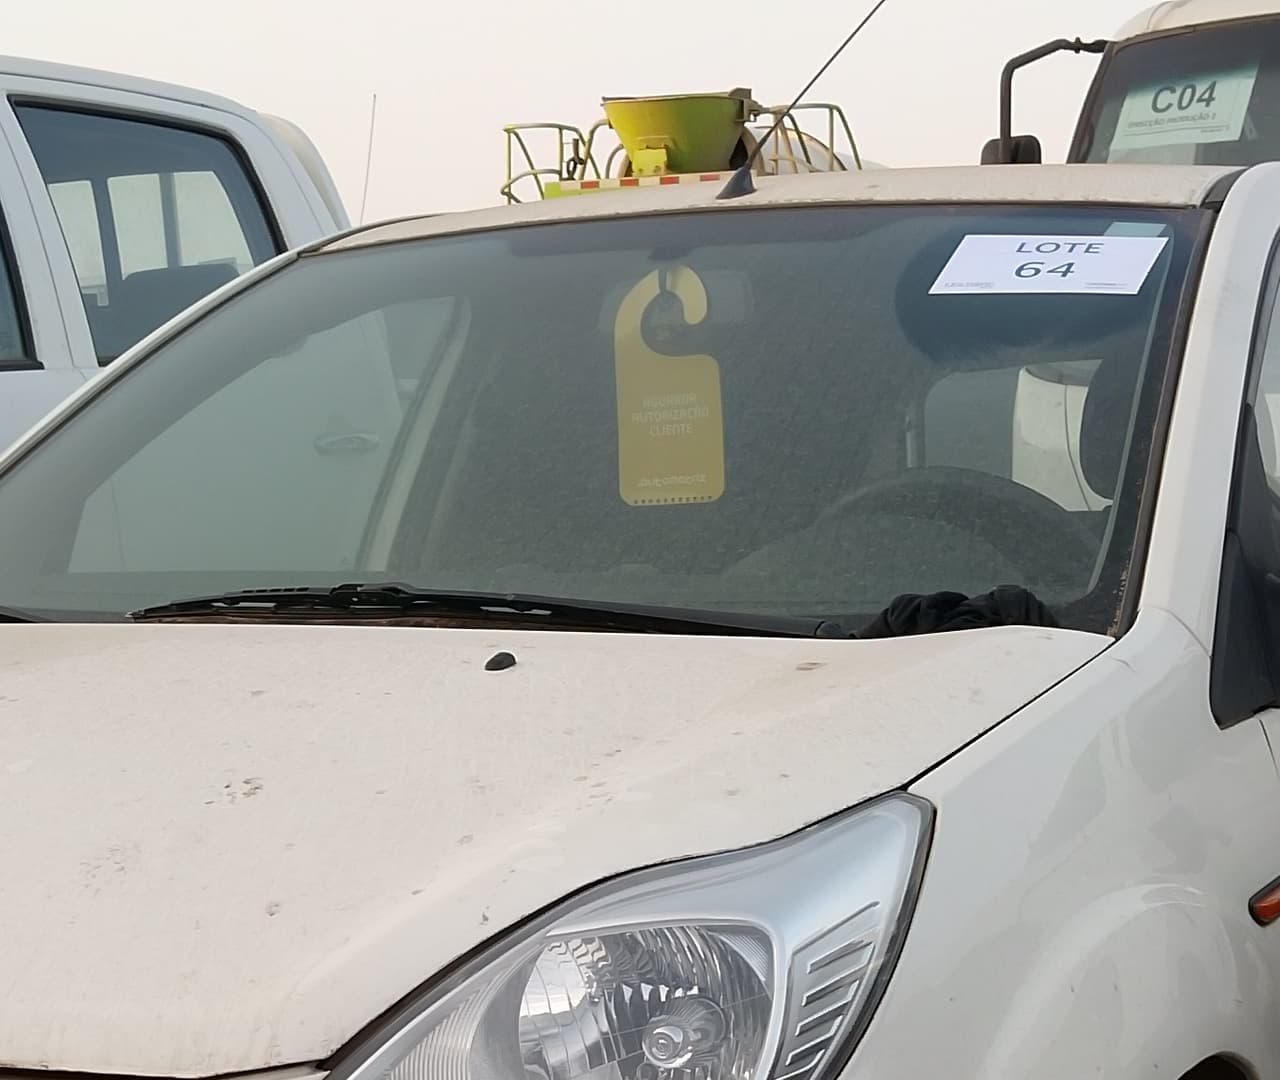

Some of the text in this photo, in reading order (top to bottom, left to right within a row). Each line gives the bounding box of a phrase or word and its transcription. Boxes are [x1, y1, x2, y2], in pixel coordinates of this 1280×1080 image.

[1151, 81, 1217, 114] C04
[1016, 242, 1105, 254] LOTE
[1014, 261, 1075, 279] 64
